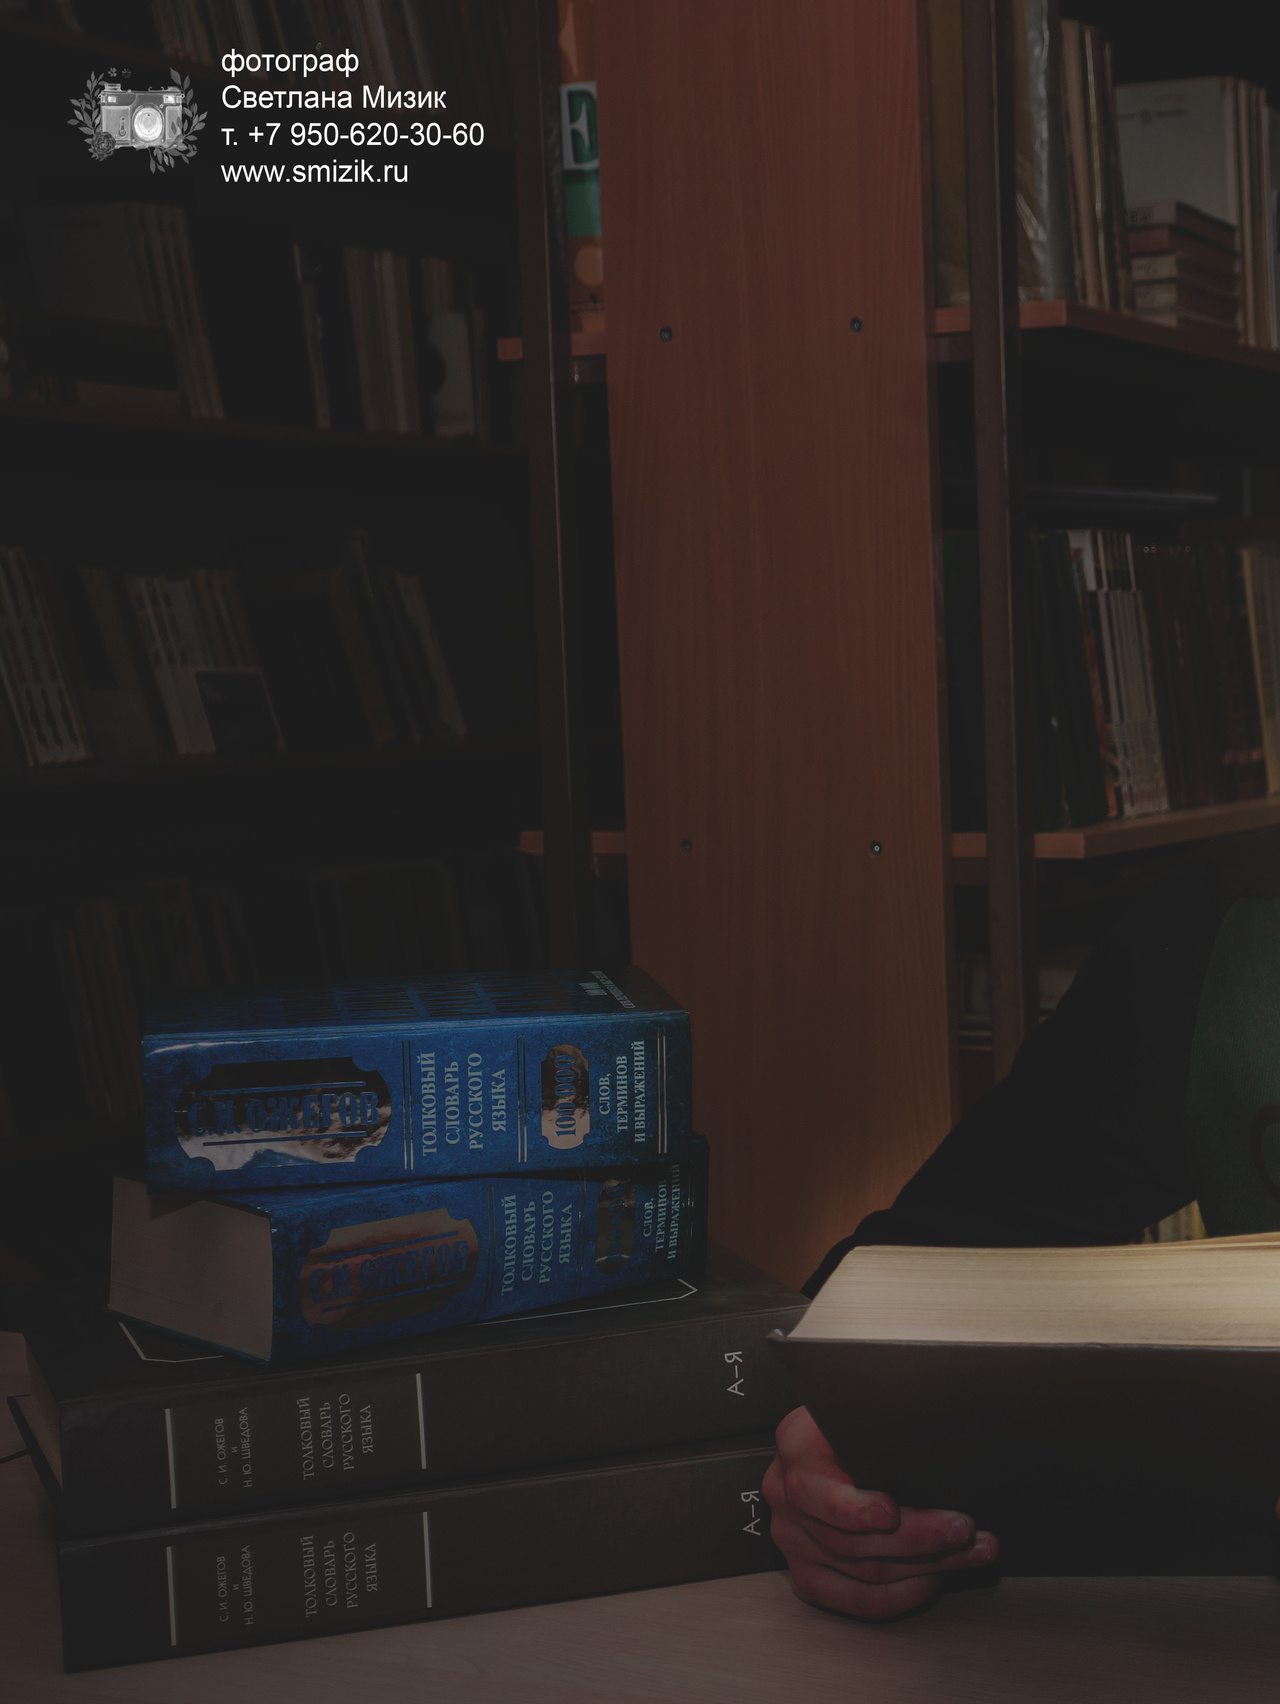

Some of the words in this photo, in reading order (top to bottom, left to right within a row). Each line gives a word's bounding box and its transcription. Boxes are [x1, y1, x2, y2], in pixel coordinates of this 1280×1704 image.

[246, 1091, 380, 1134] ОЖЕГОВ
[417, 1052, 437, 1156] ТОЛКОВЫЙ
[444, 1061, 460, 1145] СЛОВАРЬ
[467, 1053, 484, 1150] РУССКОГО
[491, 1068, 507, 1132] ЯЗЫКА
[599, 1073, 612, 1116] СЛОВ,
[616, 1055, 628, 1133] ТЕРМИНОВ
[631, 1040, 645, 1131] ВЫРАЖЕНИЙ
[634, 1132, 646, 1143] И
[521, 1200, 536, 1282] СЛОВАРЬ
[539, 1190, 555, 1284] РУССКОГО
[558, 1203, 573, 1264] ЯЗЫКА
[655, 1180, 668, 1253] ТЕРМИНОВ
[359, 1240, 469, 1294] ОЖЕГОВ
[501, 1194, 518, 1296] ТОЛКОВЫЙ
[667, 1250, 677, 1260] И
[214, 1418, 227, 1461] ОЖЕГОВ
[238, 1406, 251, 1460] ШВЕДОВА
[296, 1396, 315, 1481] ТОЛКОВЫЙ
[320, 1401, 335, 1469] СЛОВАРЬ
[338, 1393, 355, 1471] РУССКОГО
[360, 1403, 374, 1454] ЯЗЫКА
[218, 1462, 227, 1474] И.
[218, 1474, 228, 1485] С.
[242, 1461, 252, 1476] Ю.
[243, 1476, 253, 1488] Н.
[216, 1555, 228, 1598] ОЖЕГОВ
[241, 1544, 253, 1597] ШВЕДОВА
[300, 1535, 318, 1618] ТОЛКОВЫЙ
[323, 1540, 338, 1607] СЛОВАРЬ
[343, 1531, 359, 1609] РУССКОГО
[364, 1542, 378, 1592] ЯЗЫКА
[219, 1599, 228, 1611] И.
[219, 1611, 229, 1622] С.
[243, 1598, 253, 1613] Ю.
[244, 1613, 254, 1626] Н.
